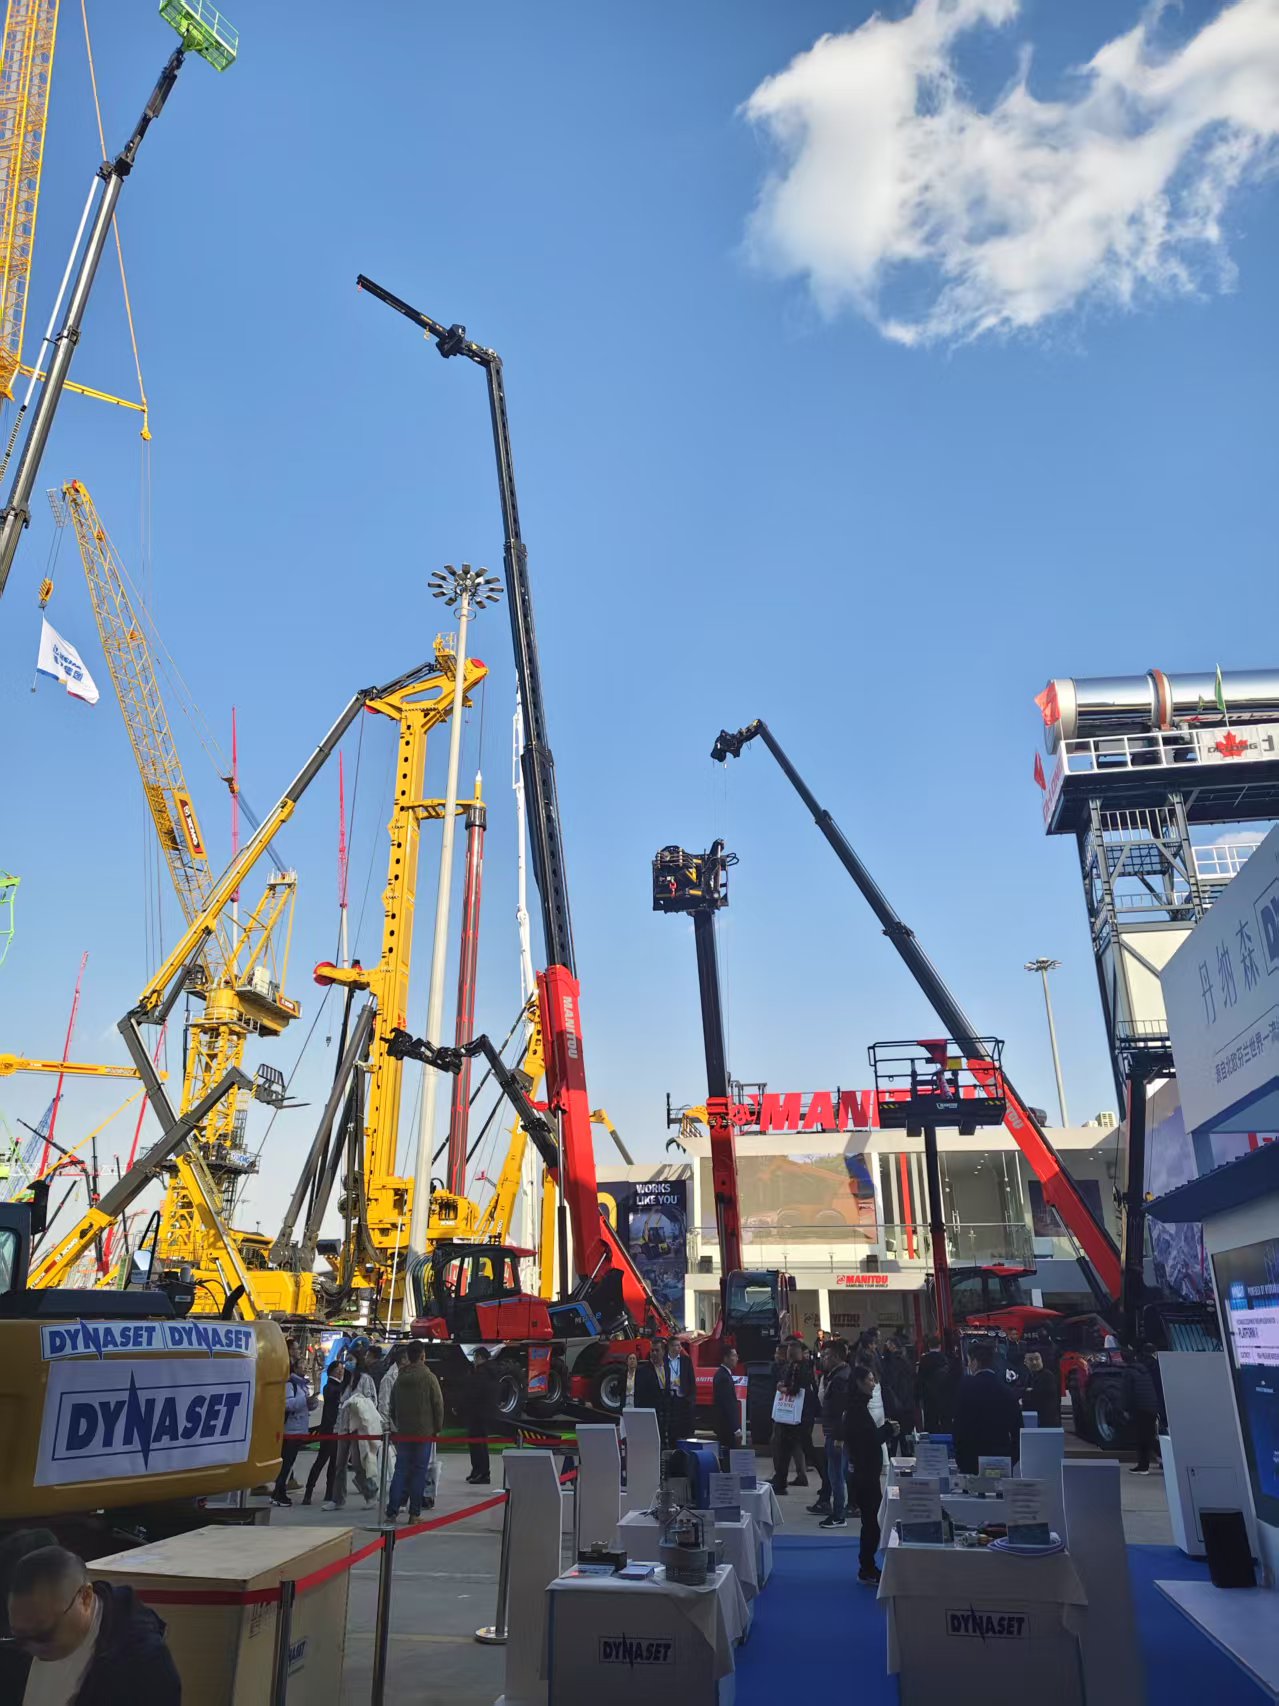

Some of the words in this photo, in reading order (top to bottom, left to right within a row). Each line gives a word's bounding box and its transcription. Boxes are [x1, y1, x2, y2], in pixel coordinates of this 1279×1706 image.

[1199, 919, 1261, 1025] 丹纳森
[563, 996, 578, 1059] MANITOU
[759, 1085, 976, 1131] MANI
[636, 1184, 671, 1193] WORKS
[636, 1196, 656, 1205] LIKE
[658, 1196, 678, 1204] YOU
[846, 1275, 888, 1284] MANITOU
[50, 1320, 155, 1360] DYNASET
[168, 1321, 252, 1357] DYNASET
[66, 1370, 242, 1471] DYNASET
[950, 1603, 1025, 1644] DYNASET
[603, 1633, 672, 1669] DYNASET
